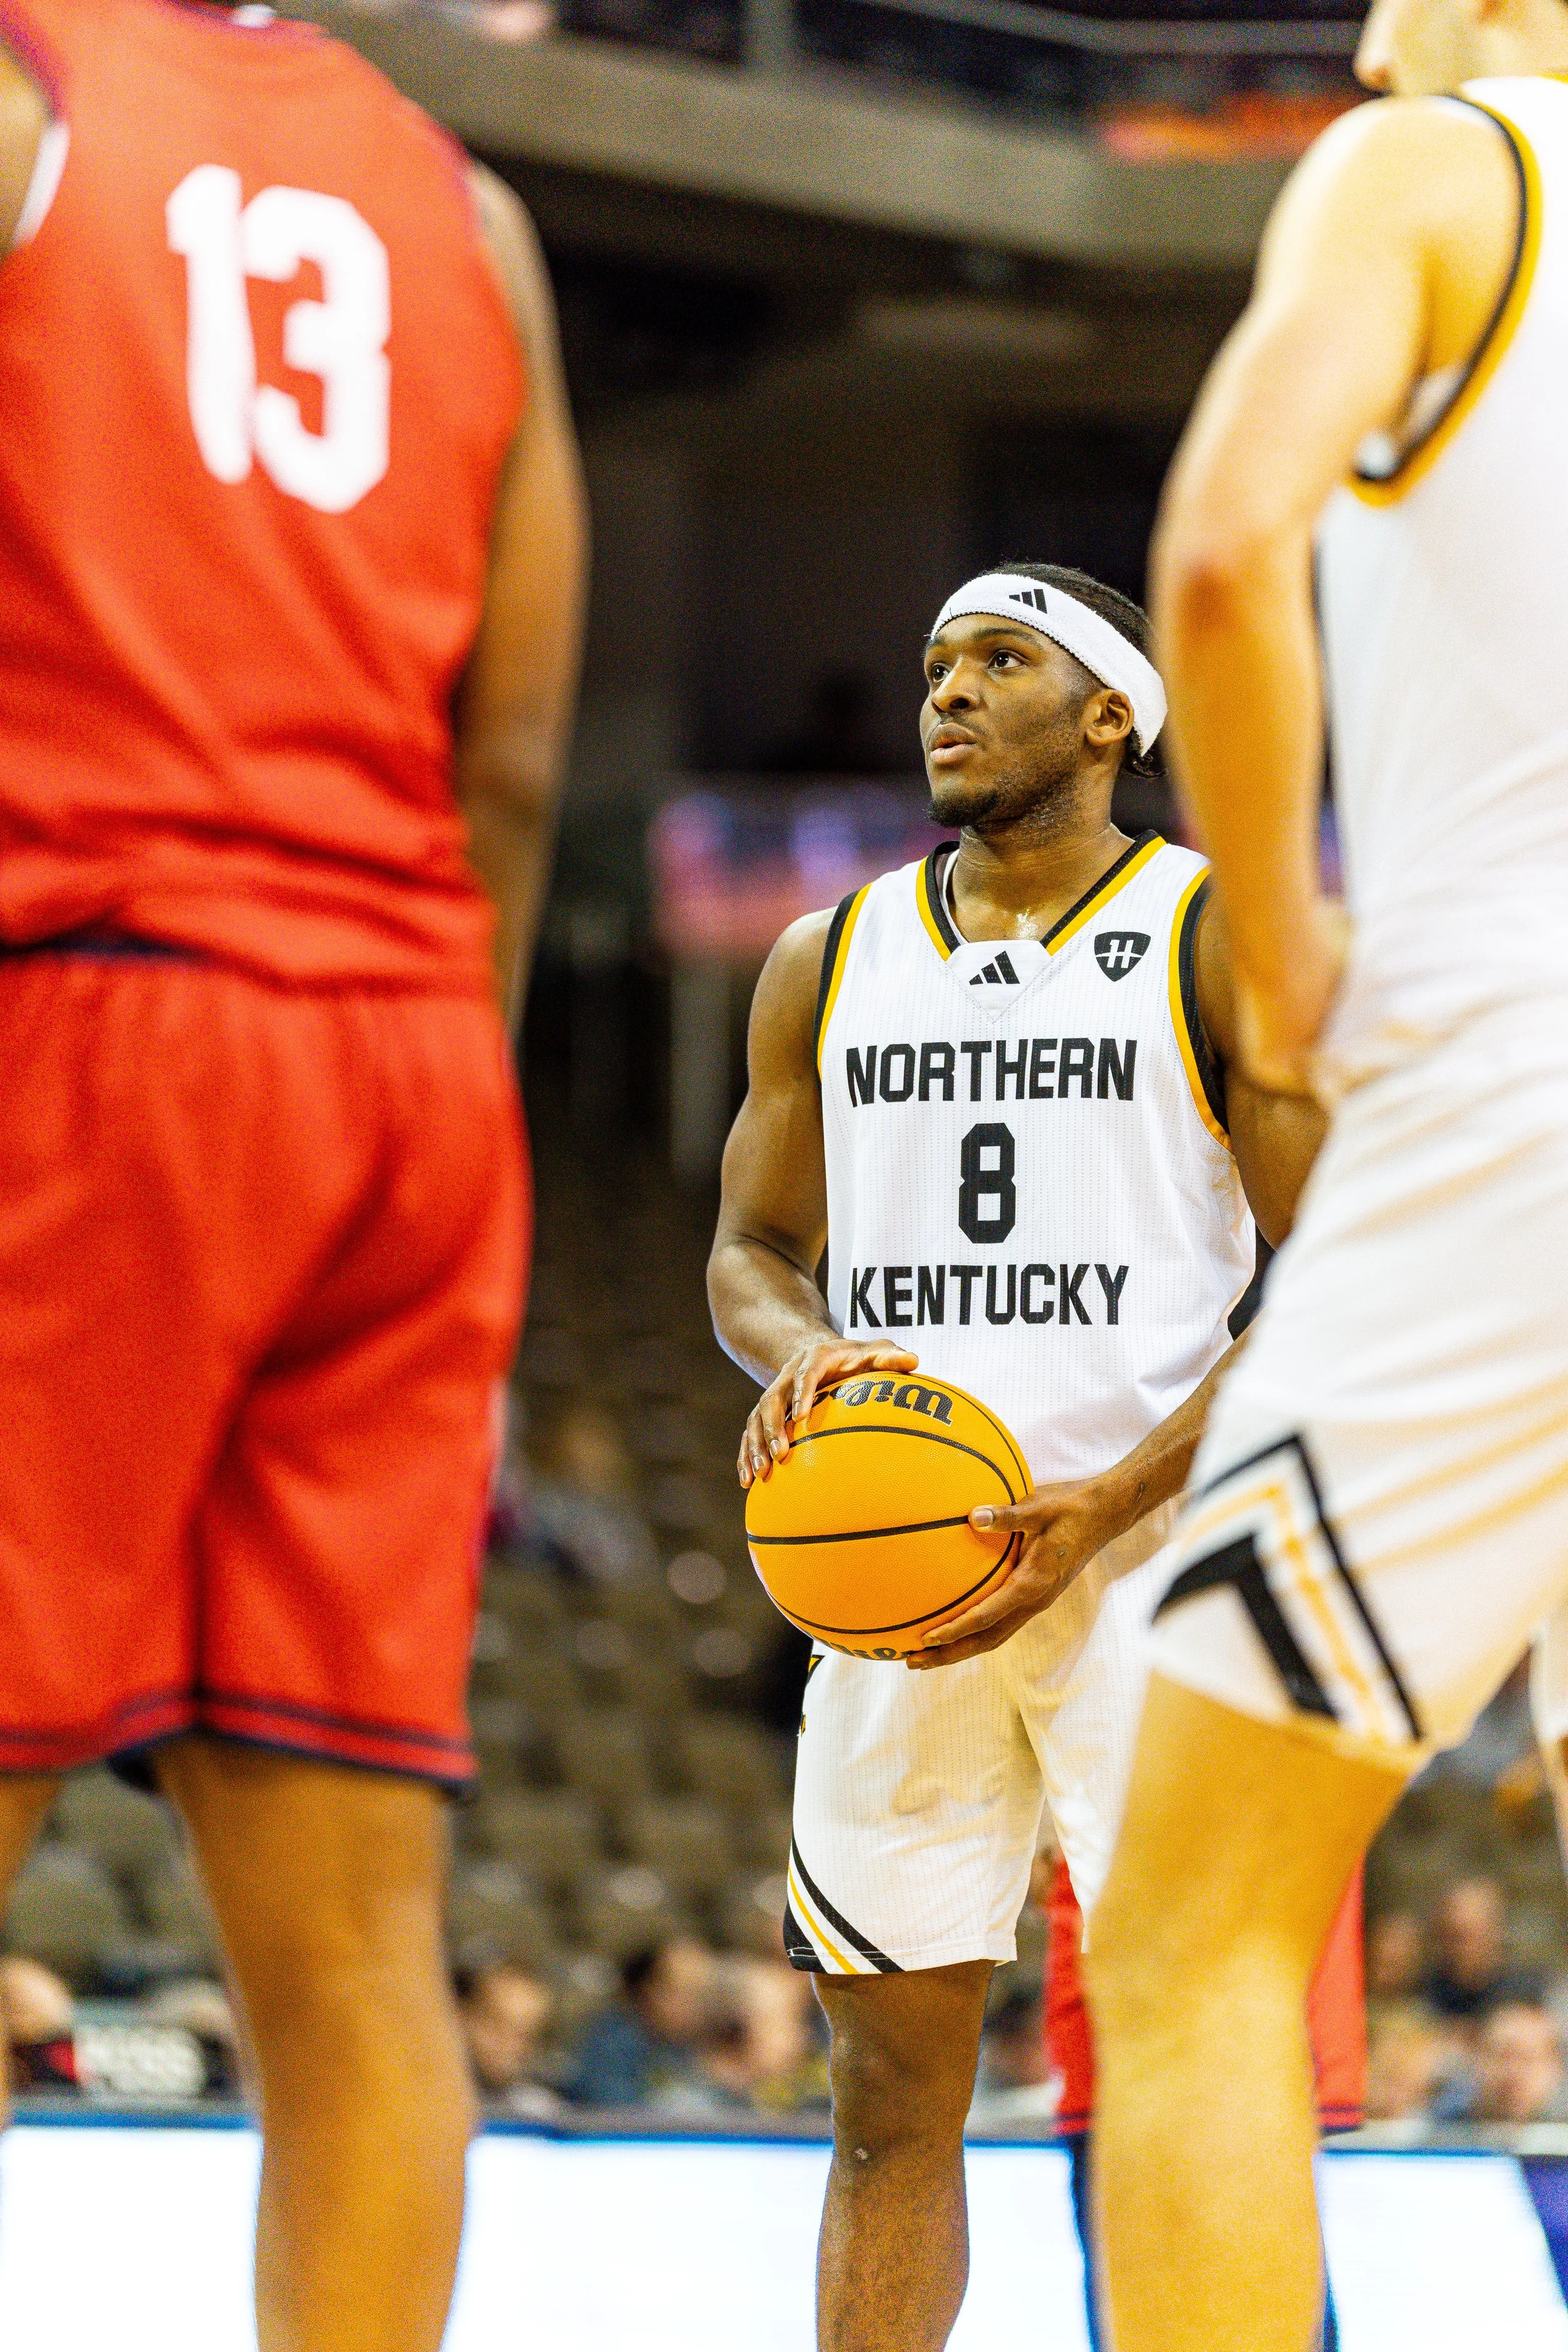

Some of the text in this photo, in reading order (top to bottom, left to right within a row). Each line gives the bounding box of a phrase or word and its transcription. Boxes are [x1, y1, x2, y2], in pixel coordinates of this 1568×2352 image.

[167, 164, 391, 513] 13
[847, 1039, 1137, 1107] NORTHERN
[958, 1123, 1015, 1244] 8
[850, 1264, 1129, 1328] KENTUCKY
